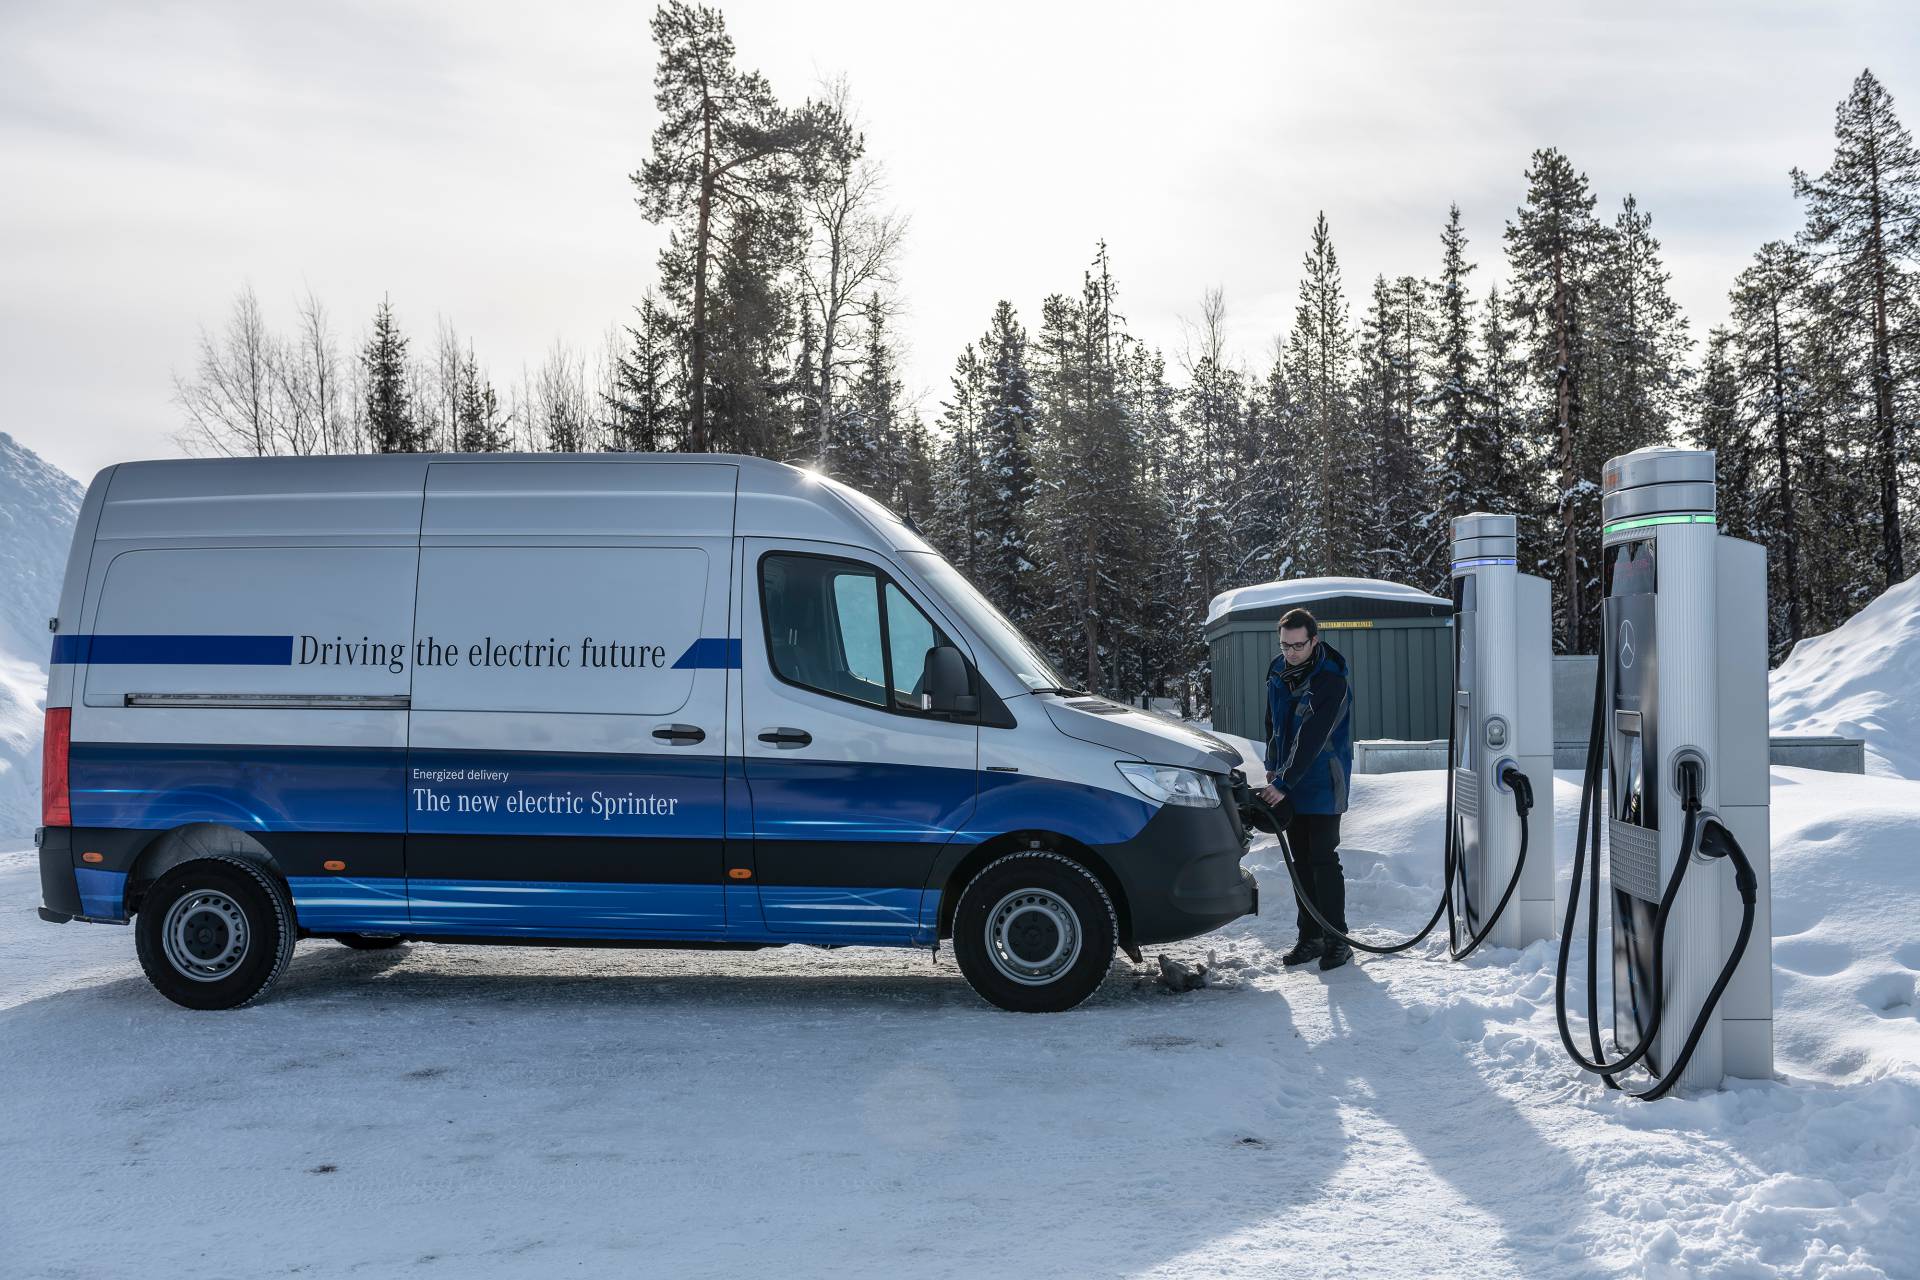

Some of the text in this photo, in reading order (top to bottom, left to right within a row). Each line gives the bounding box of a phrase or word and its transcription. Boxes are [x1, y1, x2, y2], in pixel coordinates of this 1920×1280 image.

[298, 635, 666, 675] Driving the electric future
[413, 767, 510, 784] Energized delivery
[412, 788, 679, 821] The new electric Sprinter
